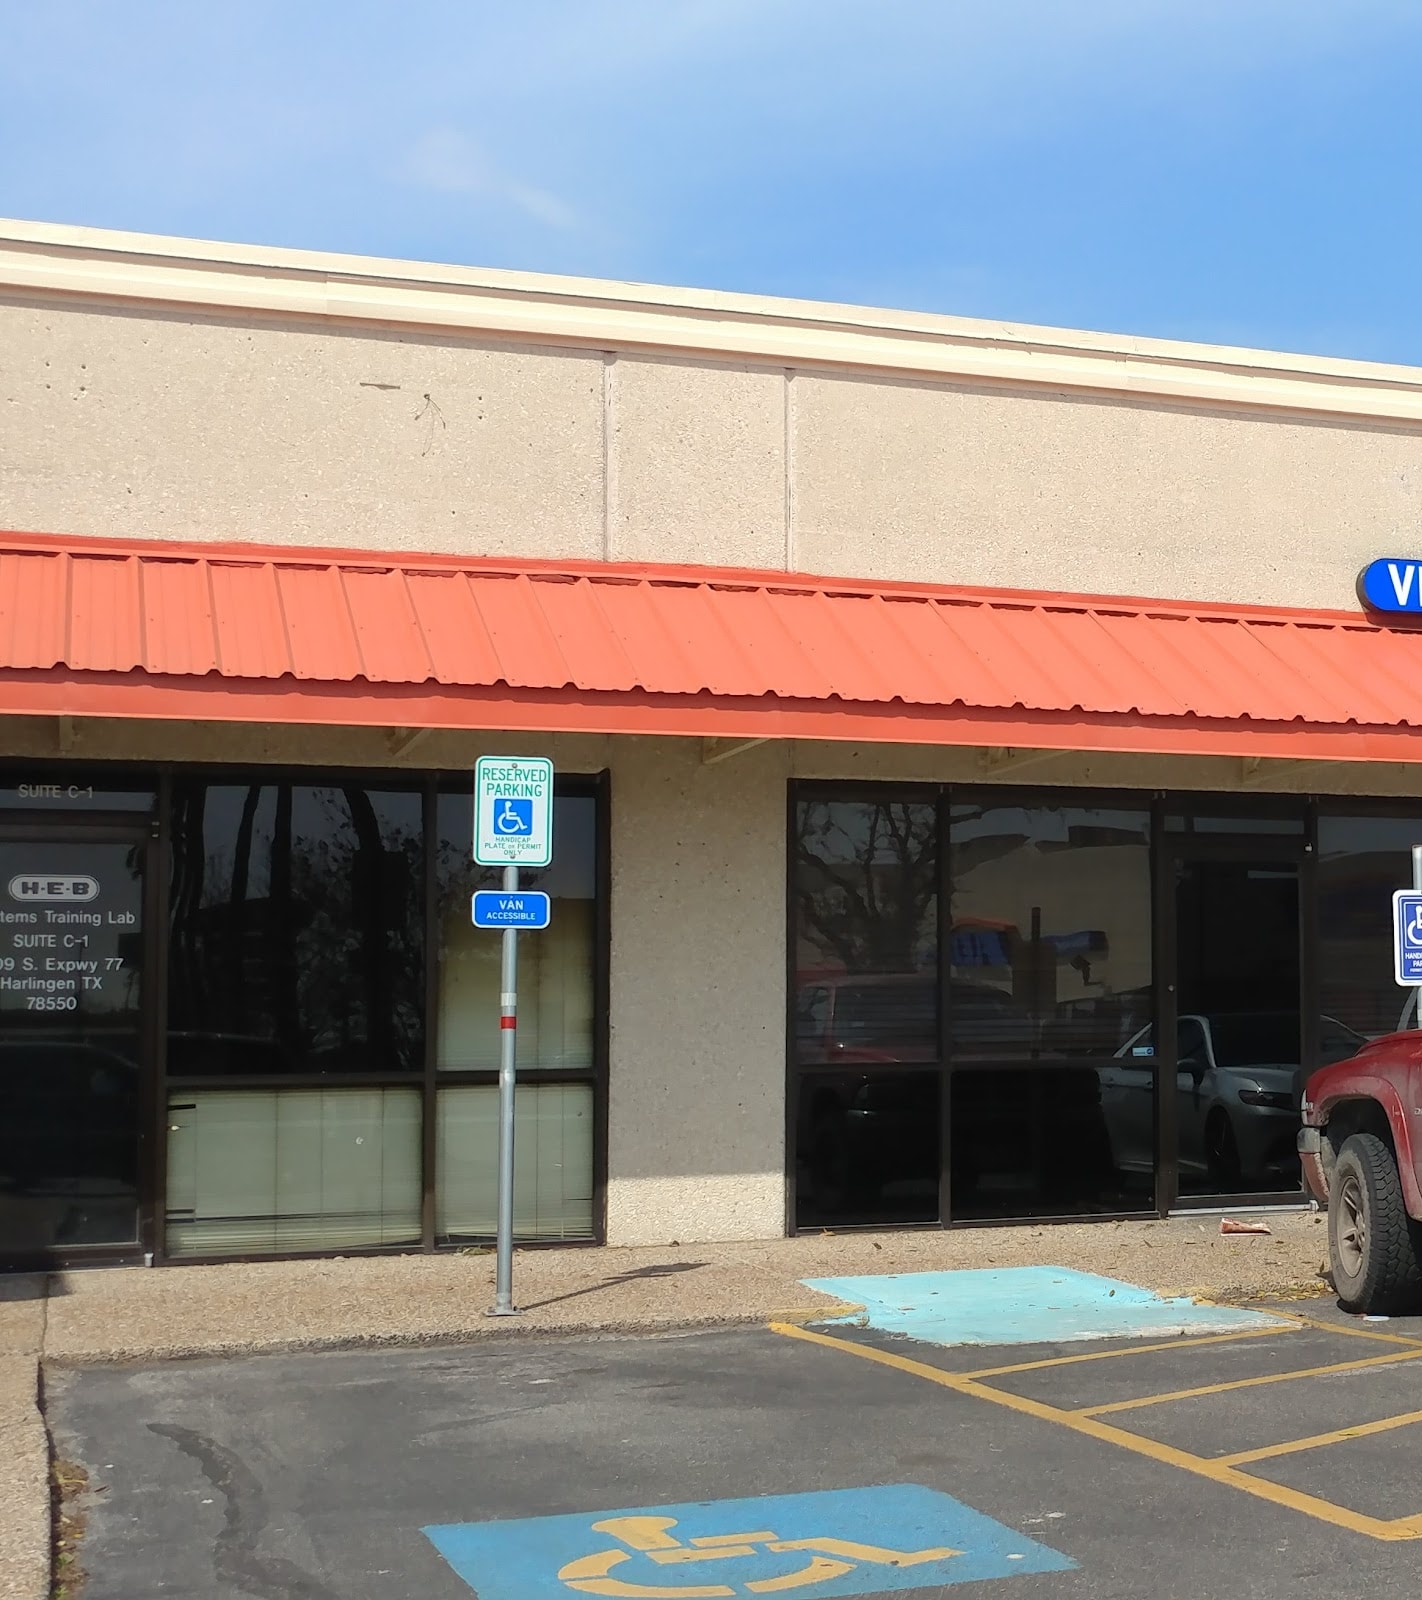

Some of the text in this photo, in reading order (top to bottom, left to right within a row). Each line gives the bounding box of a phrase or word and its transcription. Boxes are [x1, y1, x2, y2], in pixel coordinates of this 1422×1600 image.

[482, 767, 547, 783] RESERVED
[18, 784, 93, 799] SUITE C-1
[486, 782, 542, 797] PARKING
[499, 899, 523, 911] VAN
[0, 910, 136, 927] tems Training Lab
[486, 911, 536, 921] ACCESSIBLE
[13, 934, 90, 948] SUITE C-1
[22, 957, 38, 971] S.
[45, 958, 98, 973] Expwy
[104, 957, 124, 971] 77
[0, 976, 103, 993] Harlingen TX
[26, 996, 77, 1010] 78550
